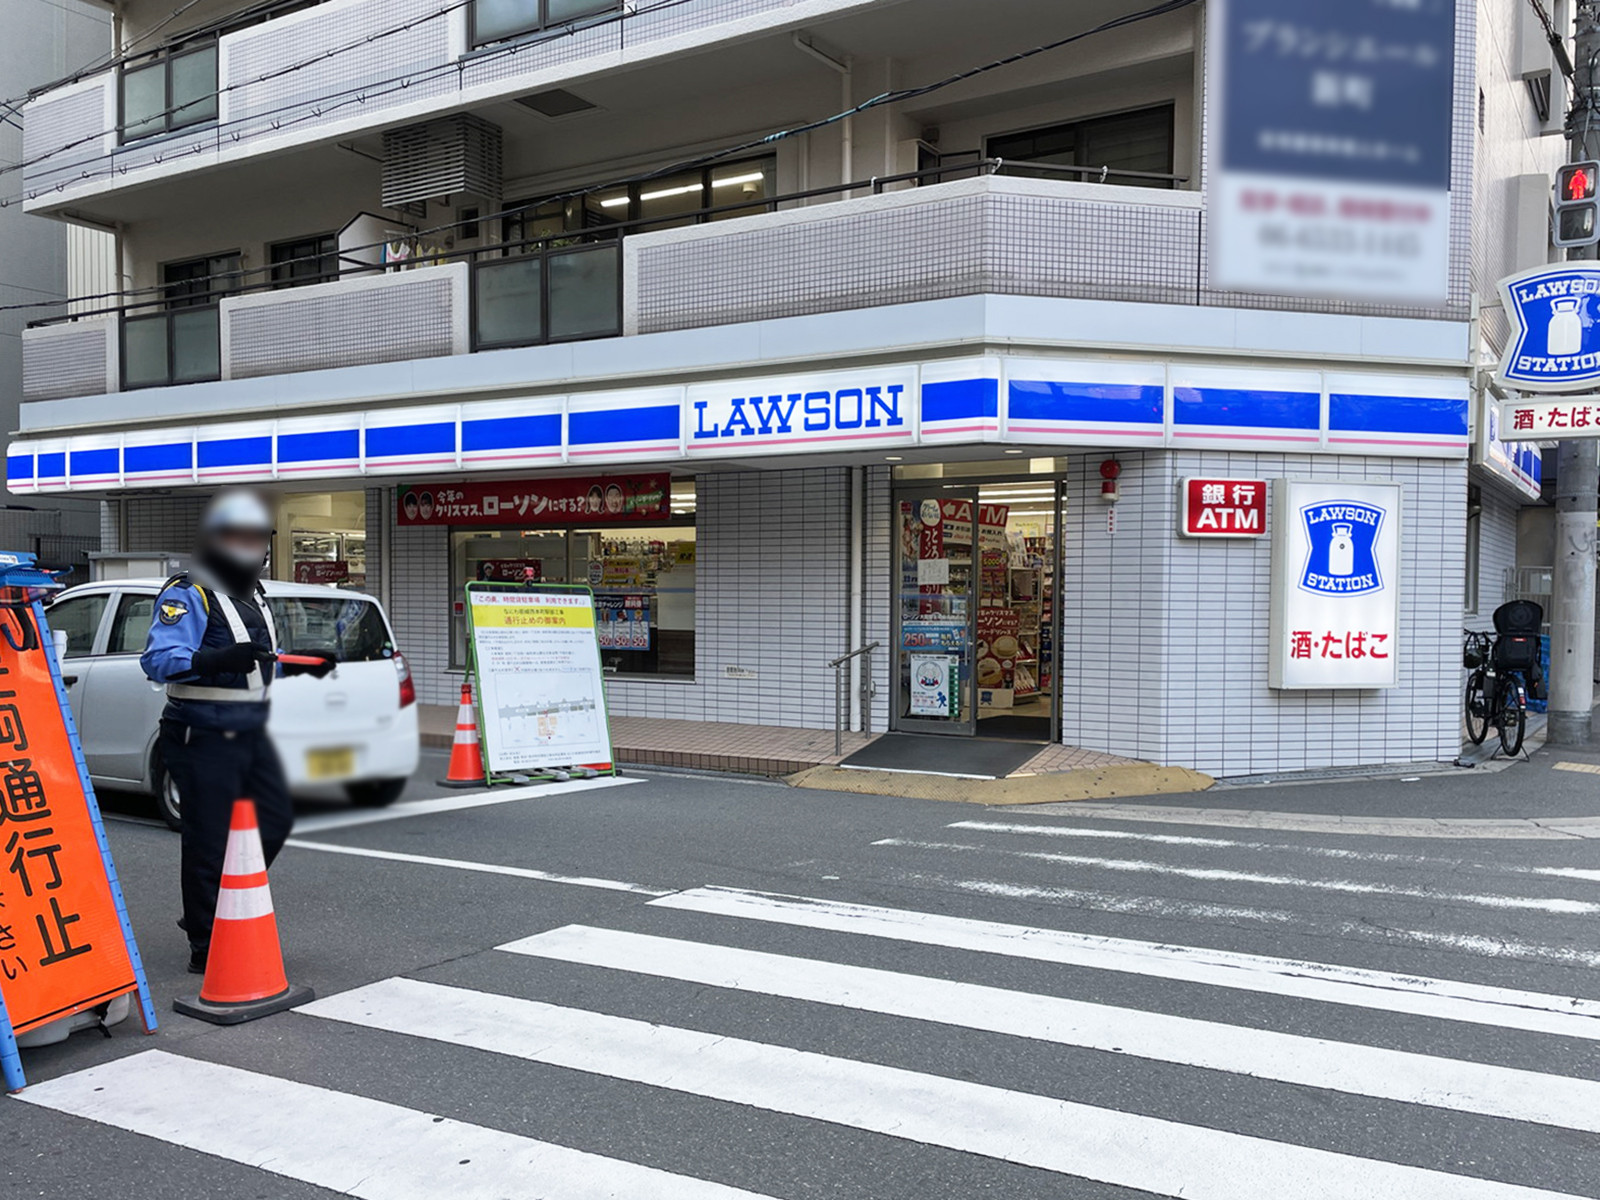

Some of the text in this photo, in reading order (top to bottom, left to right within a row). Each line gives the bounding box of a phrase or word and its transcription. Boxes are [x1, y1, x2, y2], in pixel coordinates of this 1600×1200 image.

[1519, 279, 1600, 304] LAWSO
[694, 384, 904, 439] LAWSON
[1201, 483, 1256, 506] 銀行
[1196, 508, 1259, 529] ATM
[1307, 507, 1378, 526] LAWSON
[1307, 573, 1374, 591] STATION
[1291, 630, 1389, 659] 酒・たばこ
